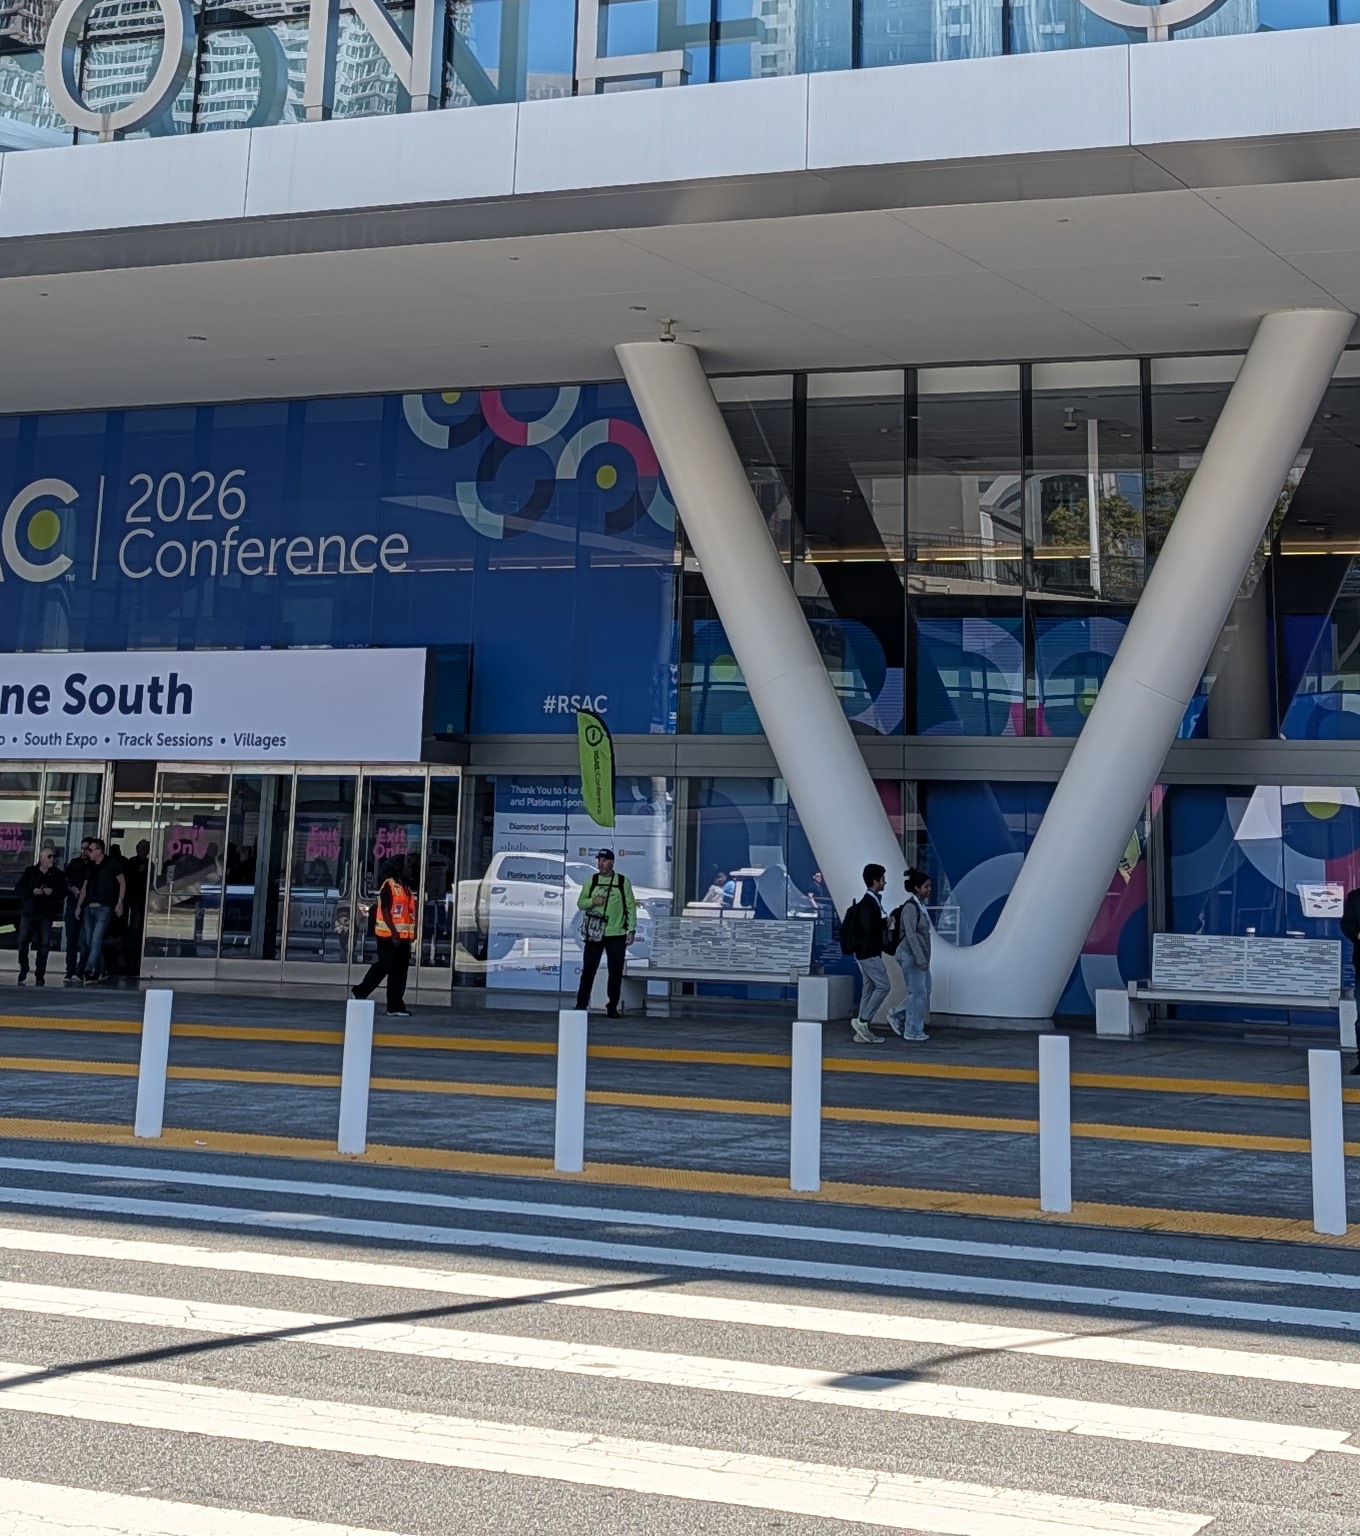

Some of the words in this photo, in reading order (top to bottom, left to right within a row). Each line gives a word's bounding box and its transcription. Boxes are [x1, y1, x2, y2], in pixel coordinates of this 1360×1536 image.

[125, 469, 247, 524] 2026
[119, 528, 410, 579] Conference
[62, 672, 193, 715] South
[543, 695, 608, 713] #RSAC
[24, 732, 62, 746] South
[66, 733, 98, 749] Expo
[117, 732, 153, 746] Track
[156, 733, 214, 747] Sessions
[233, 733, 287, 750] Villages
[511, 785, 535, 794] Thank
[536, 786, 552, 795] You
[553, 786, 562, 795] to
[510, 797, 526, 806] and
[527, 797, 561, 807] Platinum
[310, 825, 339, 841] Exit
[377, 827, 408, 842] Exit
[509, 822, 539, 830] Diamond
[306, 841, 341, 862] Only
[507, 870, 536, 879] Platinum
[537, 872, 565, 881] Sponsor
